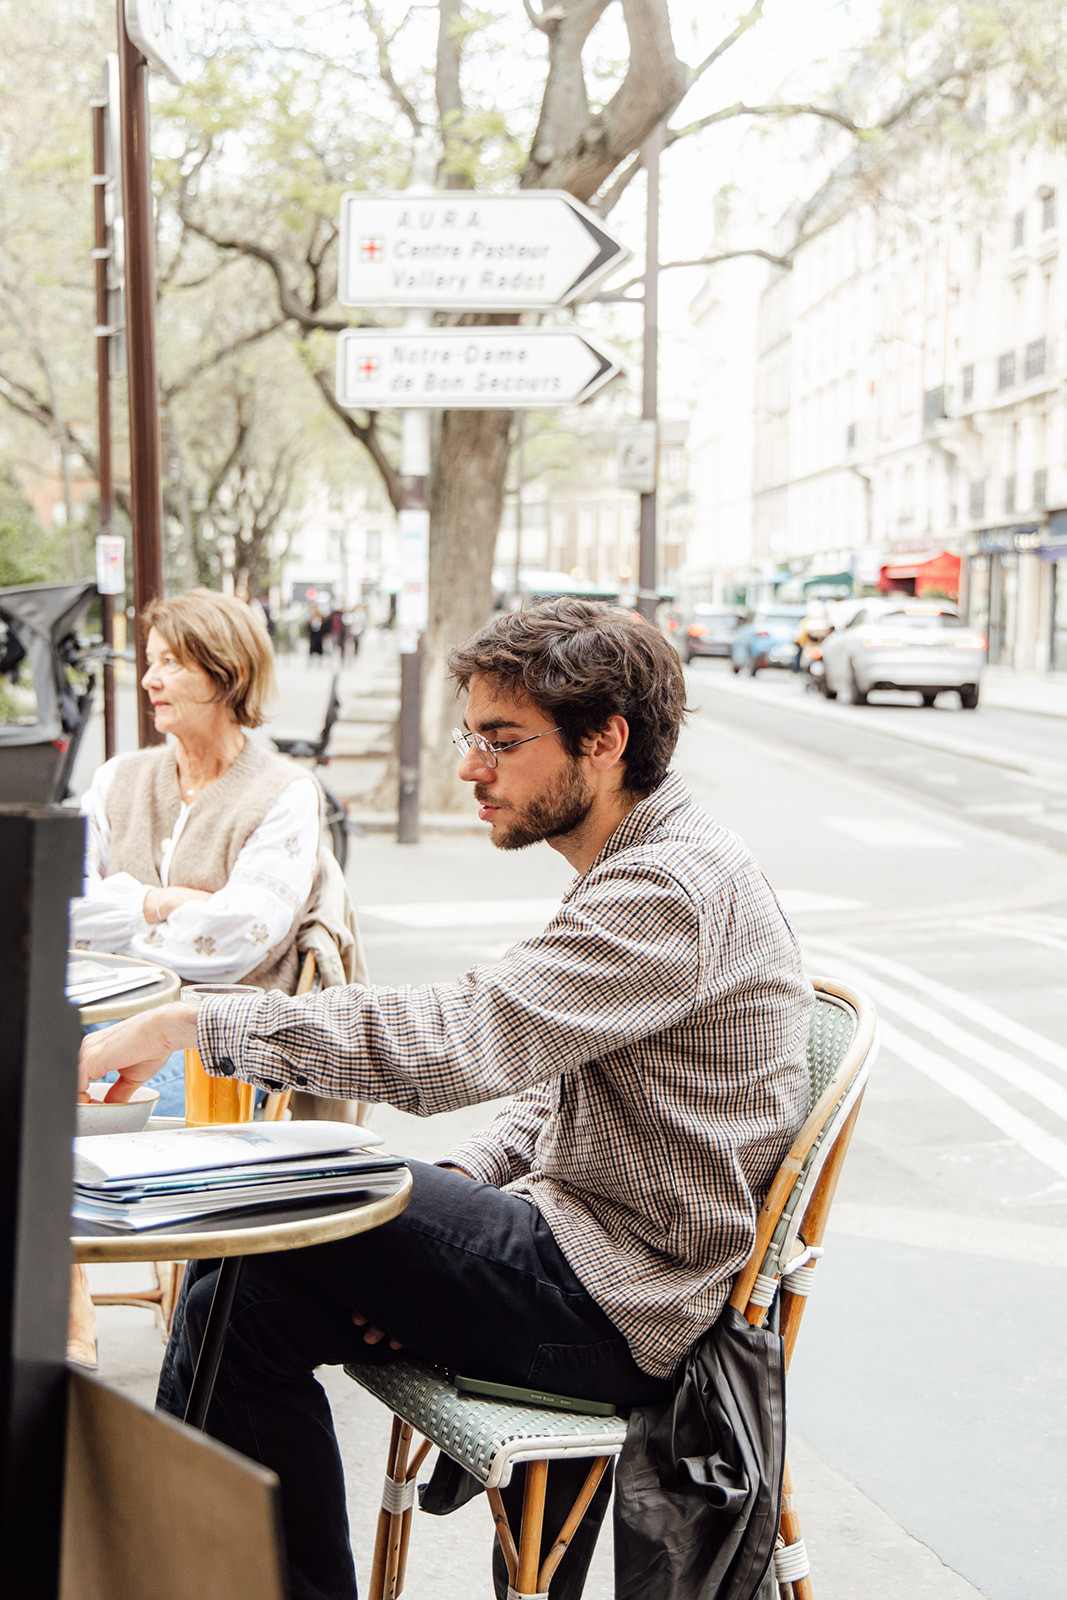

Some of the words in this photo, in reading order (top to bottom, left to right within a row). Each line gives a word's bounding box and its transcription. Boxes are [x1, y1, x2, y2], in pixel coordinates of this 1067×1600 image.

[393, 239, 461, 259] Centre
[470, 240, 550, 258] Pasteur
[392, 270, 468, 292] Vallery
[479, 270, 546, 290] Radot
[390, 374, 415, 391] de
[424, 372, 464, 391] Bon
[474, 372, 562, 392] Secours
